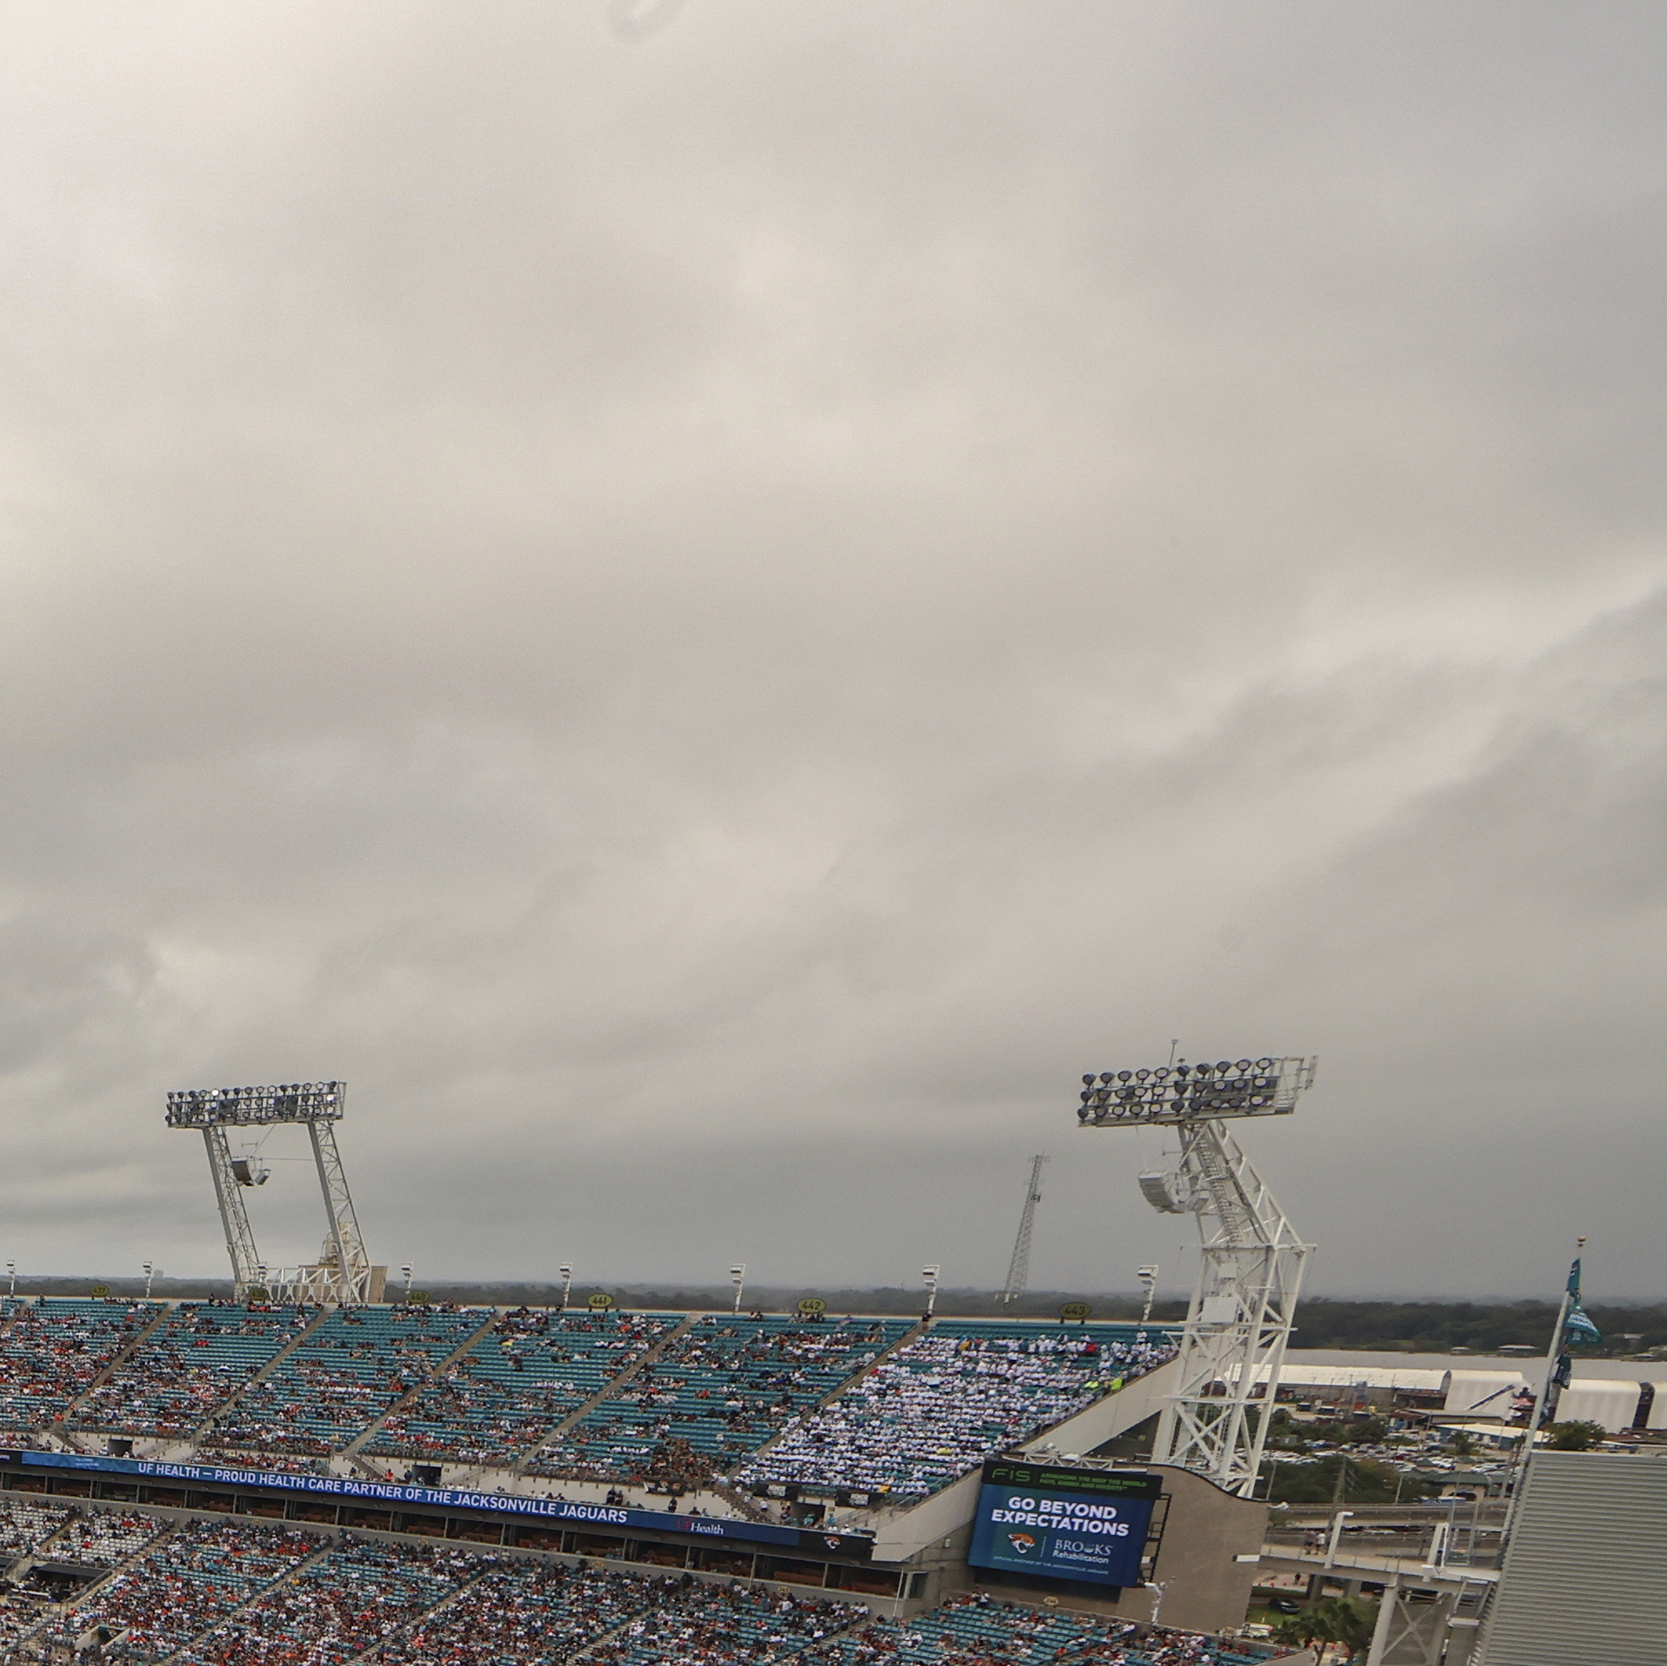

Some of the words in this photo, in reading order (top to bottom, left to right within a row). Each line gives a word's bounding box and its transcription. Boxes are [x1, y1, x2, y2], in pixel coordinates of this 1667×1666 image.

[138, 1462, 154, 1474] UF
[156, 1464, 200, 1479] HEALTH
[214, 1469, 256, 1485] PROUD
[258, 1473, 306, 1490] HEALTH
[308, 1478, 341, 1493] CARE
[344, 1482, 402, 1502] PARTNER
[405, 1490, 423, 1505] OF
[425, 1492, 451, 1508] THE
[454, 1495, 556, 1519] JACKSONVILLE
[559, 1506, 628, 1527] JAGUARS
[1008, 1496, 1036, 1511] GO
[1039, 1499, 1117, 1520] BEYOND
[691, 1521, 724, 1535] Health
[991, 1508, 1130, 1538] EXPECTATIONS
[1052, 1549, 1109, 1565] Rehabilitation
